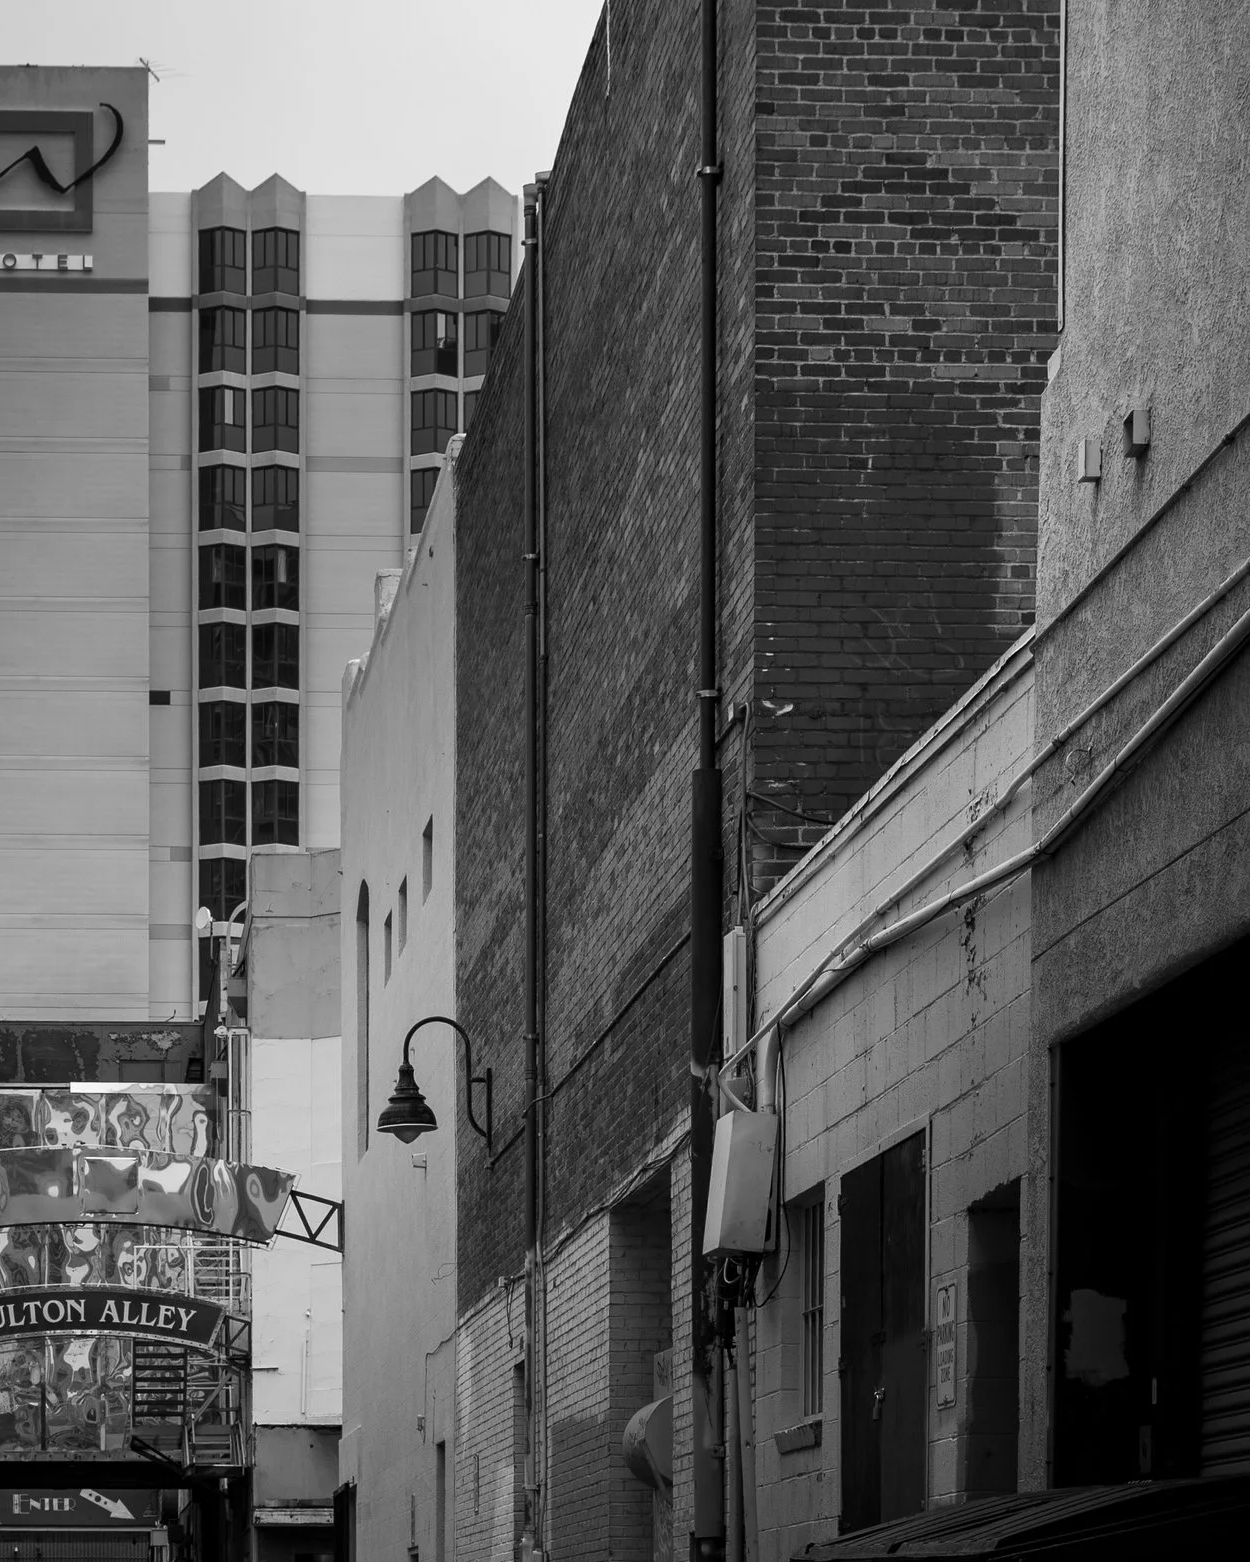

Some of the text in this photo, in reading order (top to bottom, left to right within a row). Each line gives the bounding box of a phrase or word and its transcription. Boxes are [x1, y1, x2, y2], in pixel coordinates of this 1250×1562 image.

[99, 1300, 197, 1332] ALLEY
[942, 1295, 950, 1318] NO
[937, 1321, 954, 1346] PARKING
